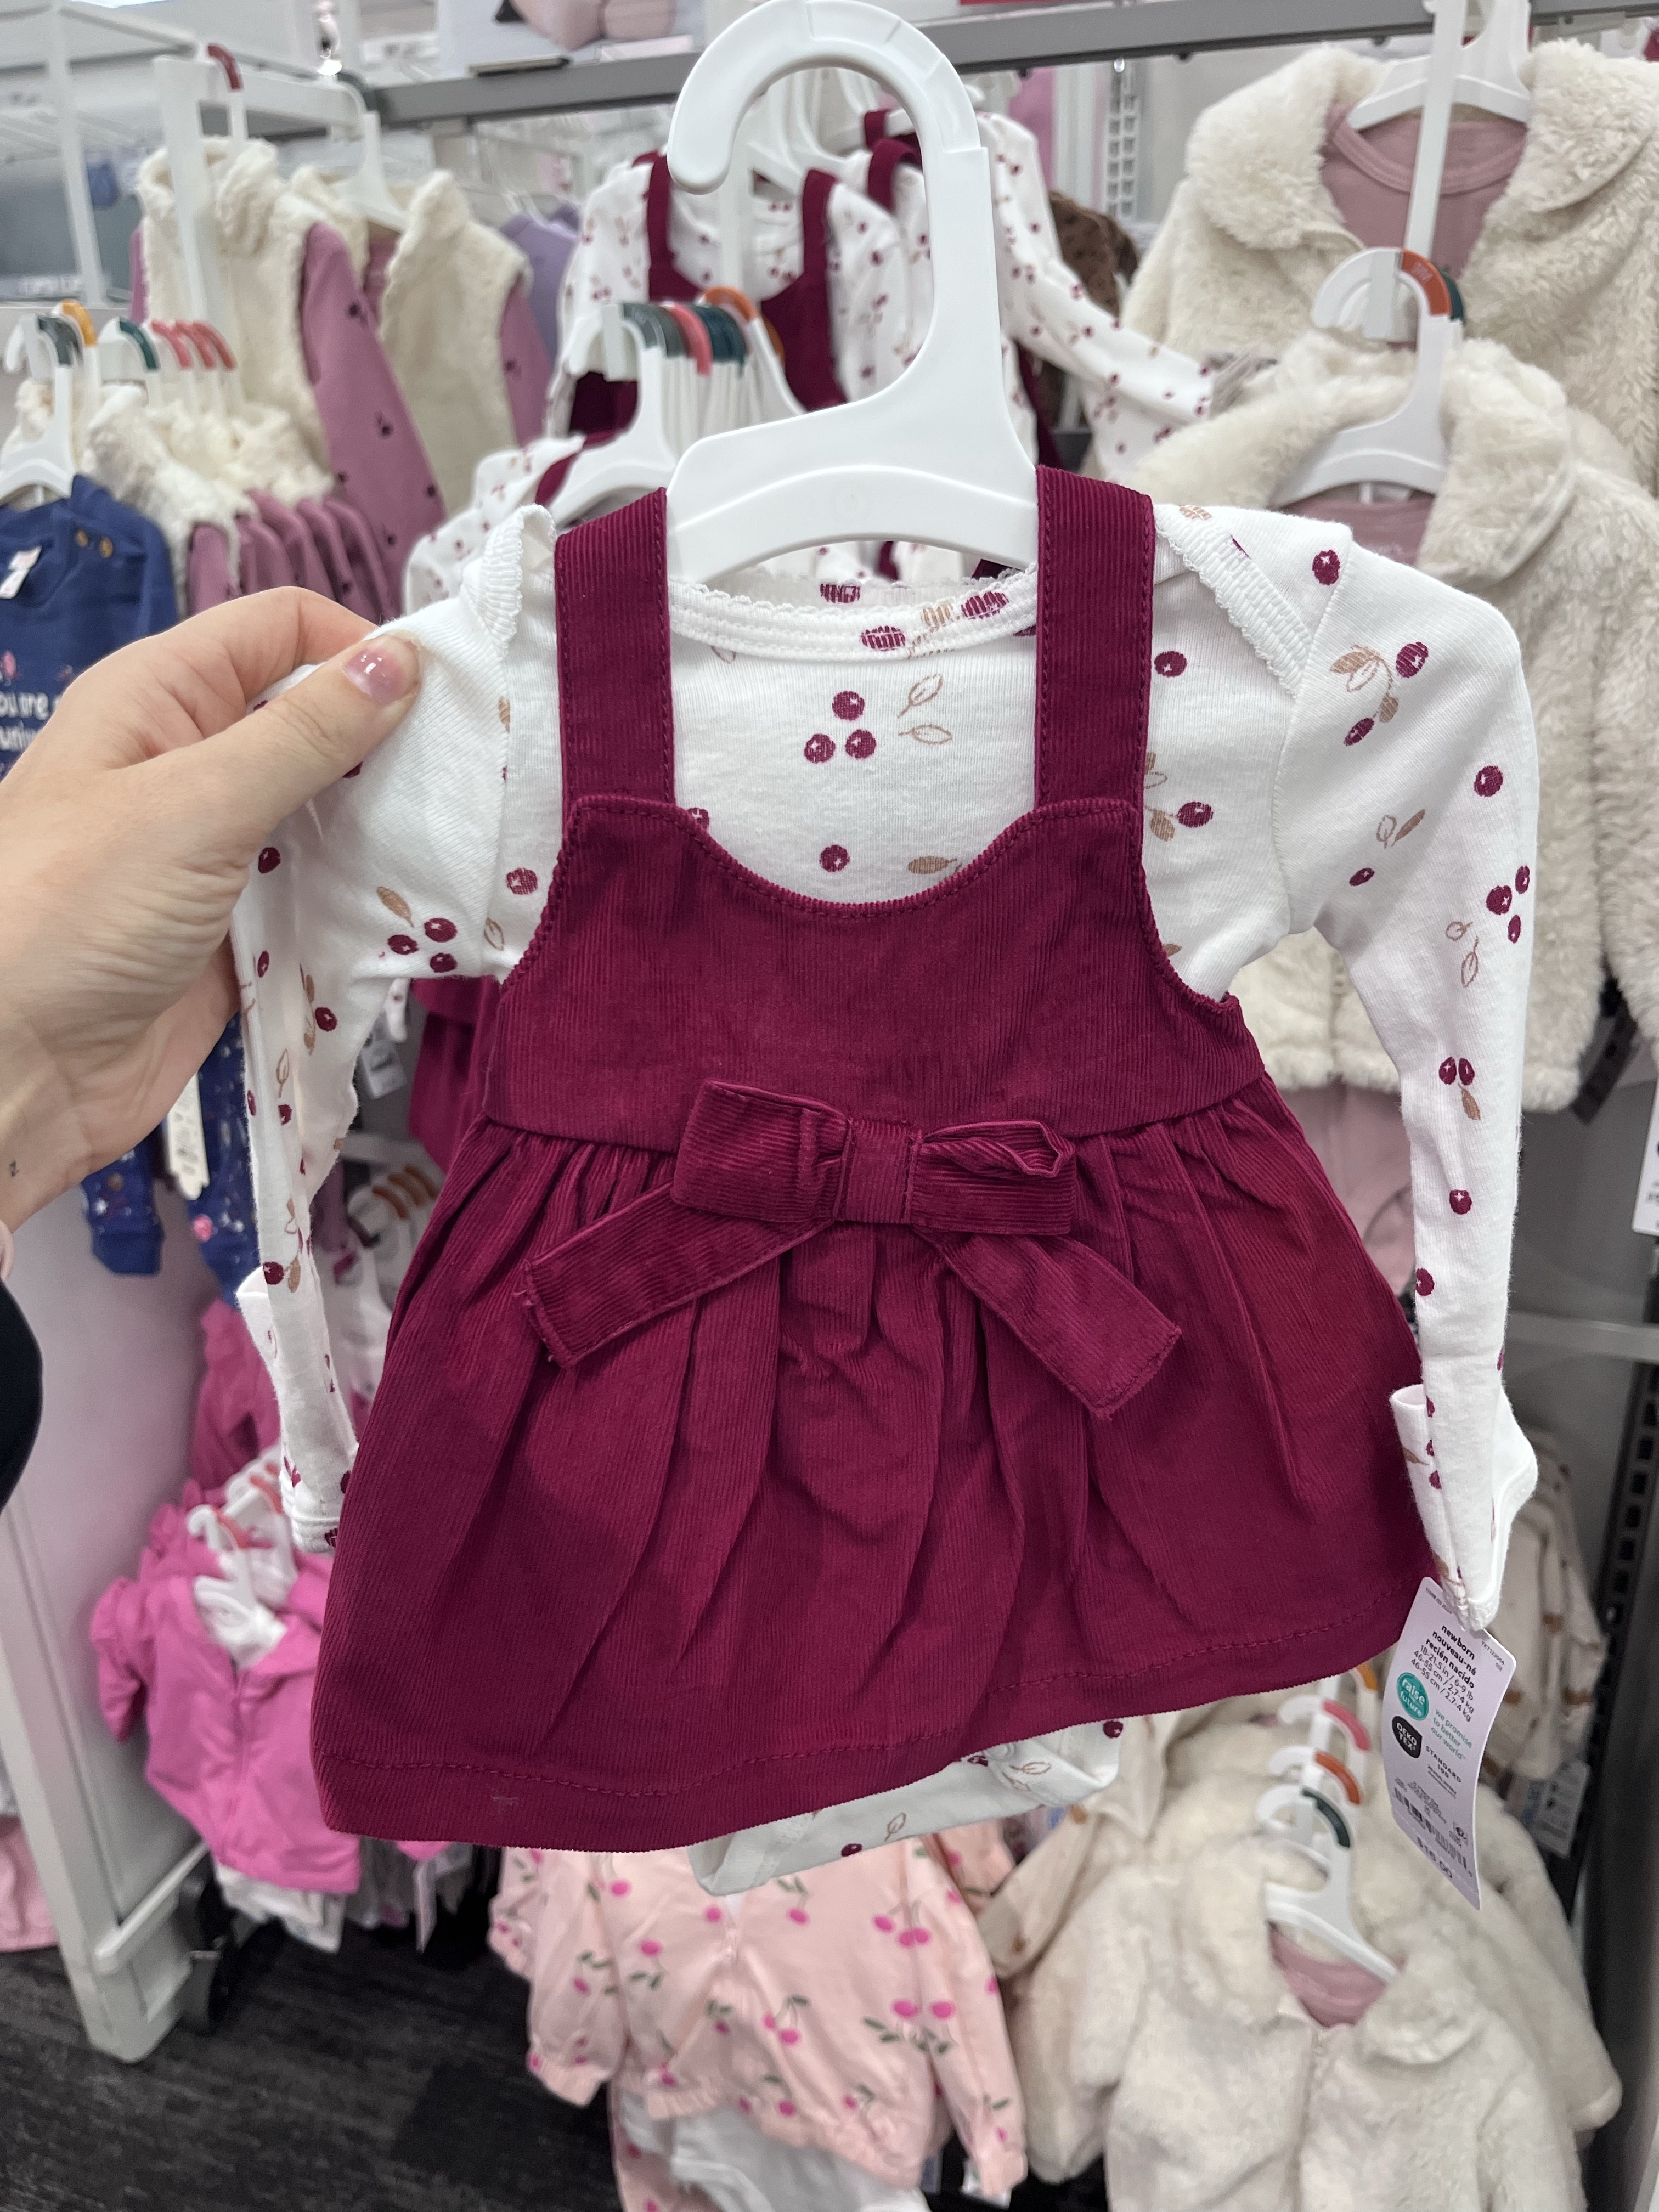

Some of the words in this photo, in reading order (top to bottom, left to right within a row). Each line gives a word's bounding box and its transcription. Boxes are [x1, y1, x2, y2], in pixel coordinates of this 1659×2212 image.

[1432, 1631, 1477, 1675] nouveau-né
[1441, 1625, 1475, 1660] newborn
[1414, 1650, 1433, 1671] 46-55
[1433, 1670, 1443, 1682] cm
[1465, 1700, 1474, 1714] kg
[1420, 1645, 1442, 1670] 18-21.5
[1442, 1668, 1449, 1677] in
[1454, 1679, 1466, 1692] 6-9
[1467, 1689, 1474, 1701] lb
[1426, 1639, 1448, 1664] recién
[1449, 1662, 1474, 1689] nacido
[1400, 1691, 1422, 1717] future
[1402, 1678, 1425, 1705] raise
[1411, 1658, 1430, 1679] 46-55
[1430, 1678, 1440, 1690] cm
[1462, 1707, 1471, 1722] kg
[1431, 1727, 1442, 1740] our
[1433, 1717, 1440, 1727] to
[1441, 1724, 1461, 1747] better
[1436, 1709, 1445, 1722] we
[1446, 1719, 1472, 1749] promise
[1426, 1745, 1462, 1782] STANDARD
[1437, 1764, 1449, 1778] 100
